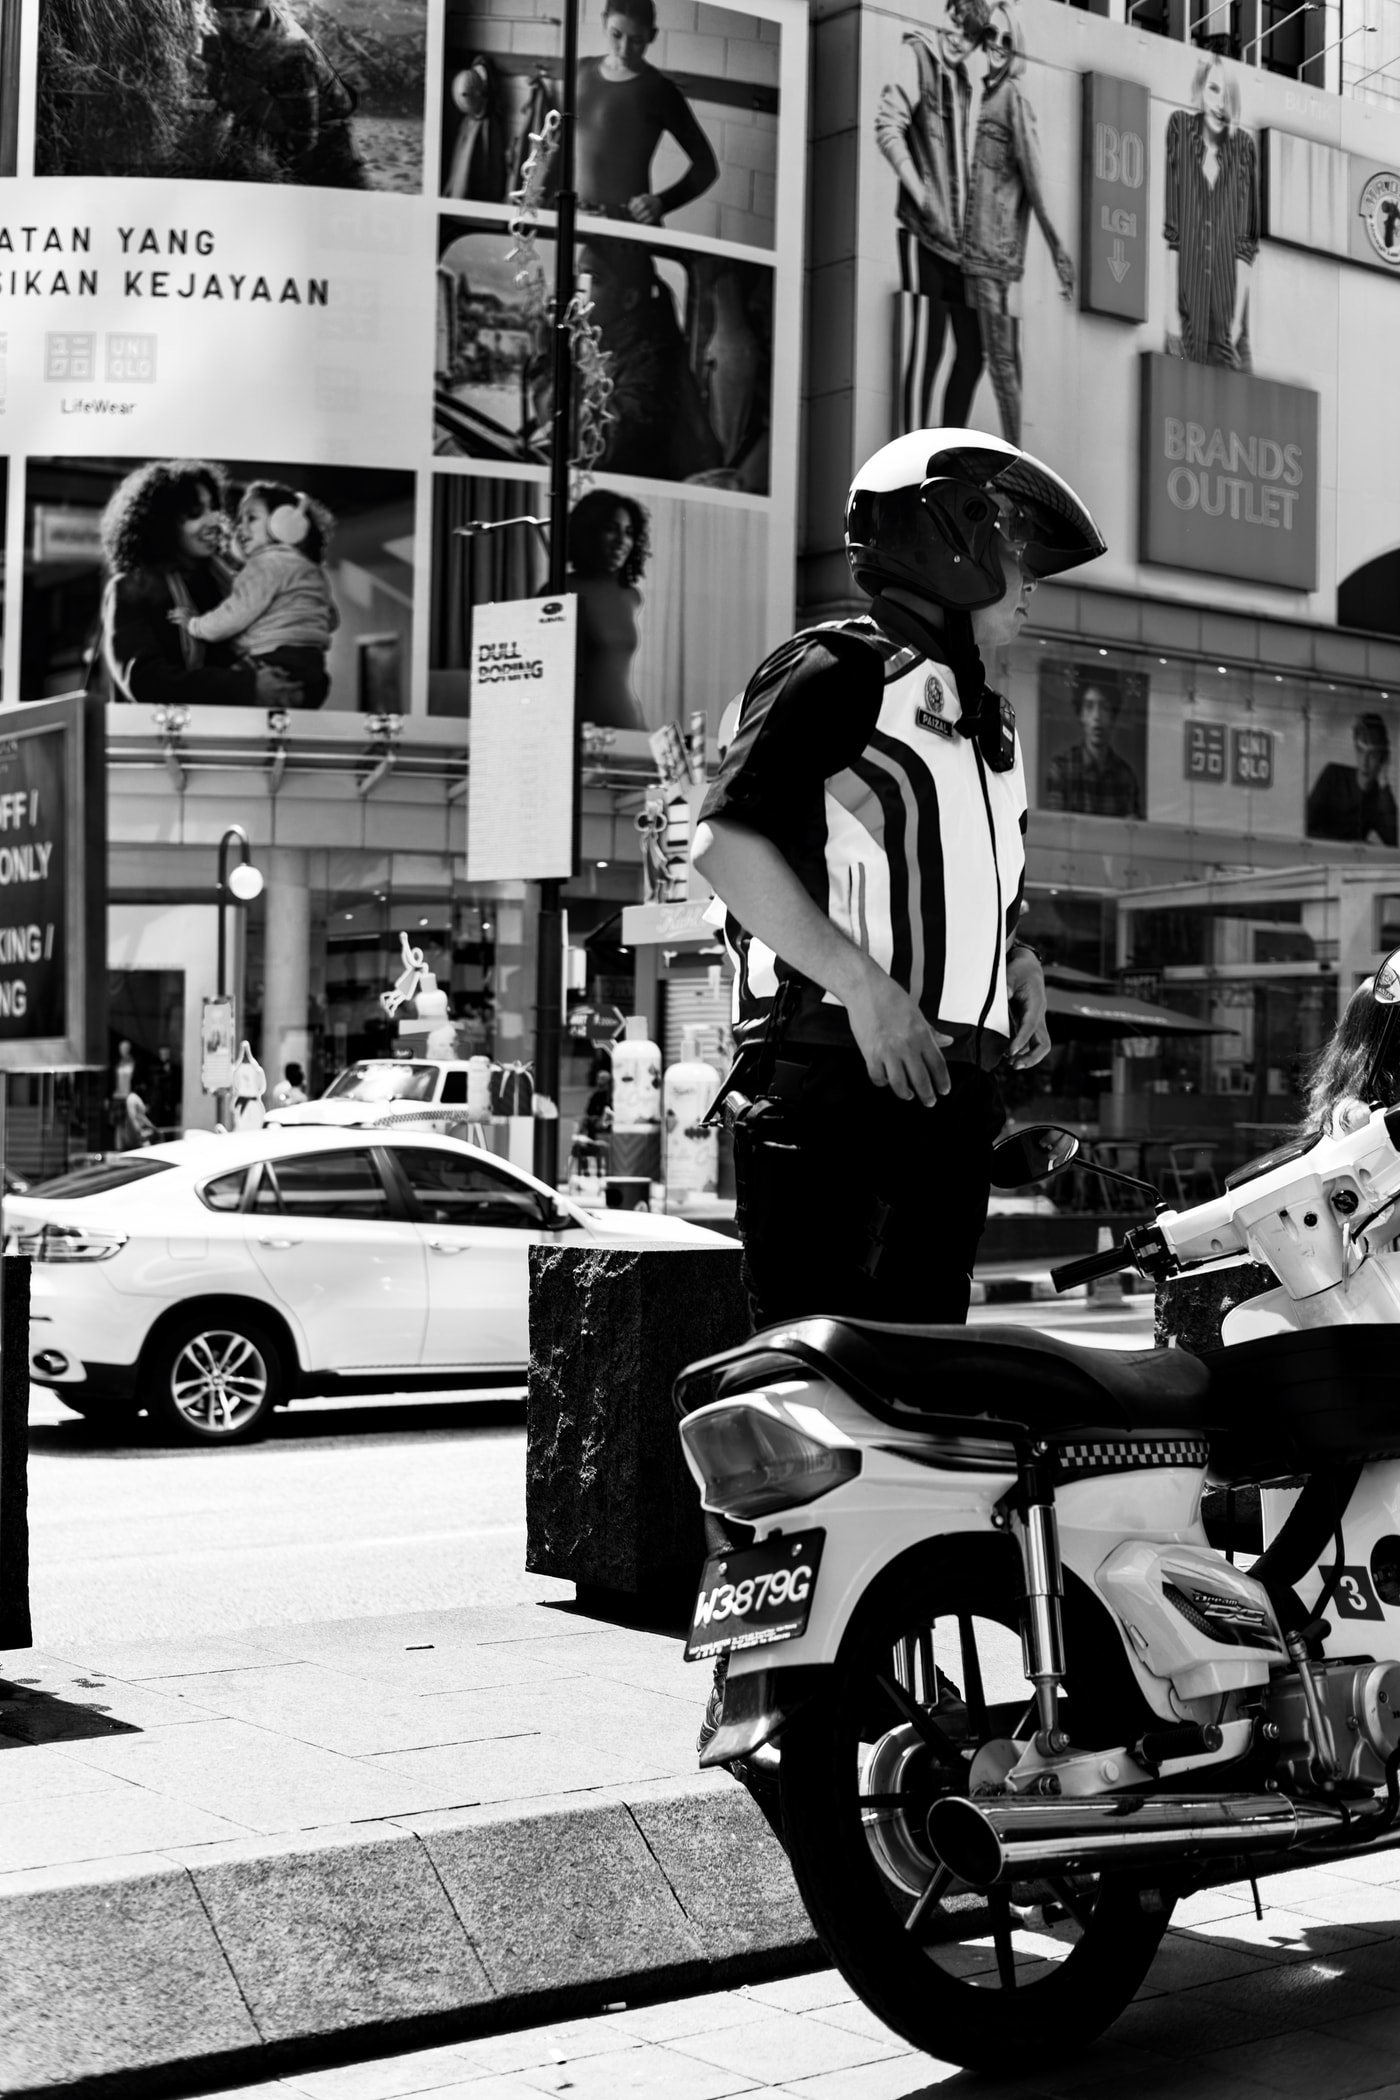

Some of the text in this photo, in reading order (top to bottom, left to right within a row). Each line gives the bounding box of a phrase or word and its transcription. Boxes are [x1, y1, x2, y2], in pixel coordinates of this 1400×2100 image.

[1095, 122, 1144, 189] BO
[117, 226, 215, 256] YANG
[124, 269, 329, 306] KEJAYAAN
[61, 398, 137, 415] LifeWear
[1164, 417, 1304, 486] BRANDS
[1167, 466, 1300, 530] OUTLET
[478, 642, 522, 662] DULL
[478, 660, 544, 684] BORING
[922, 713, 949, 735] PAIZAL
[0, 840, 53, 886] ONLY
[693, 1565, 812, 1628] W3879G
[1339, 1575, 1368, 1611] 3
